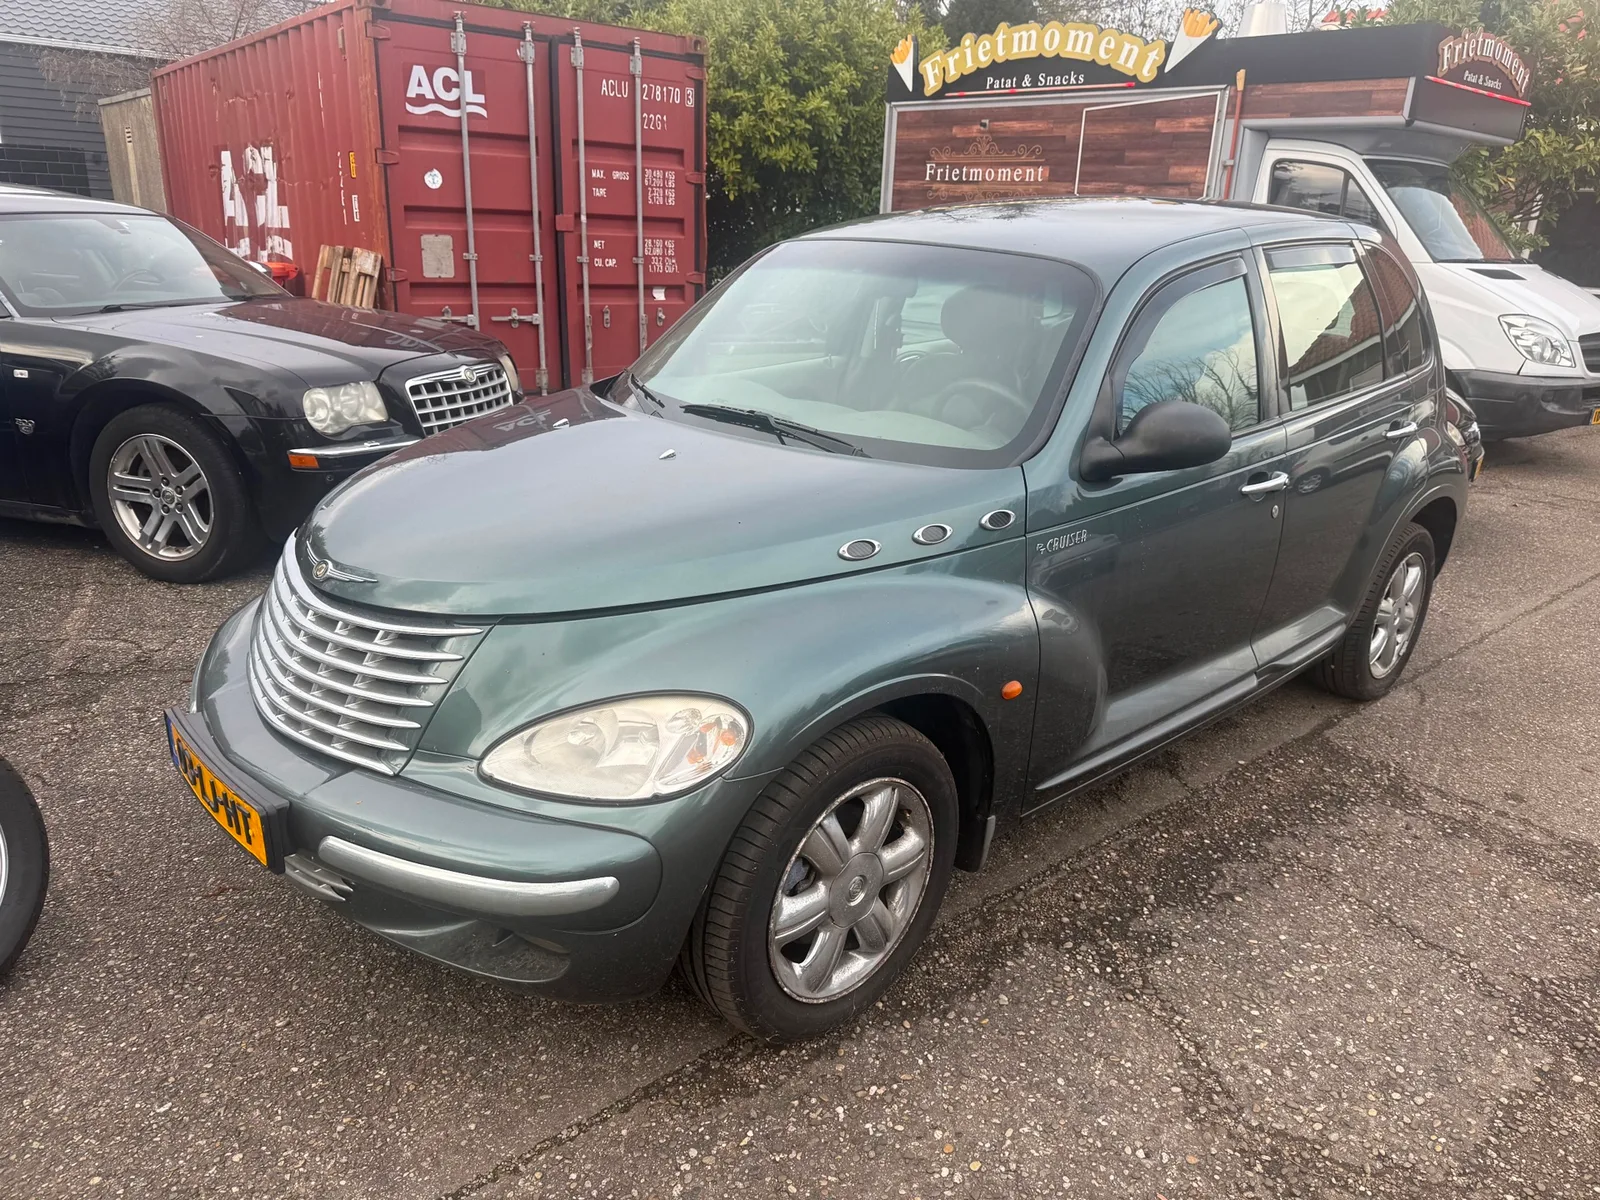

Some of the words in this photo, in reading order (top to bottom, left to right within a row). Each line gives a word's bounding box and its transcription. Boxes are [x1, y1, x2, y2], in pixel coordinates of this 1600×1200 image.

[923, 27, 1163, 89] Frietmoment
[1442, 32, 1531, 93] Frietmoment
[406, 65, 485, 103] ACL
[986, 75, 1017, 90] Patat
[1022, 74, 1032, 87] &
[1037, 71, 1085, 86] Snacks
[601, 79, 629, 98] ACLU
[642, 84, 681, 104] 278170
[686, 89, 694, 106] 3
[591, 169, 606, 179] MAX.
[612, 171, 630, 180] GROSS
[925, 163, 1044, 182] Frietmoment
[592, 188, 607, 197] TARE
[594, 240, 605, 249] NET
[1046, 529, 1088, 552] CRUISER
